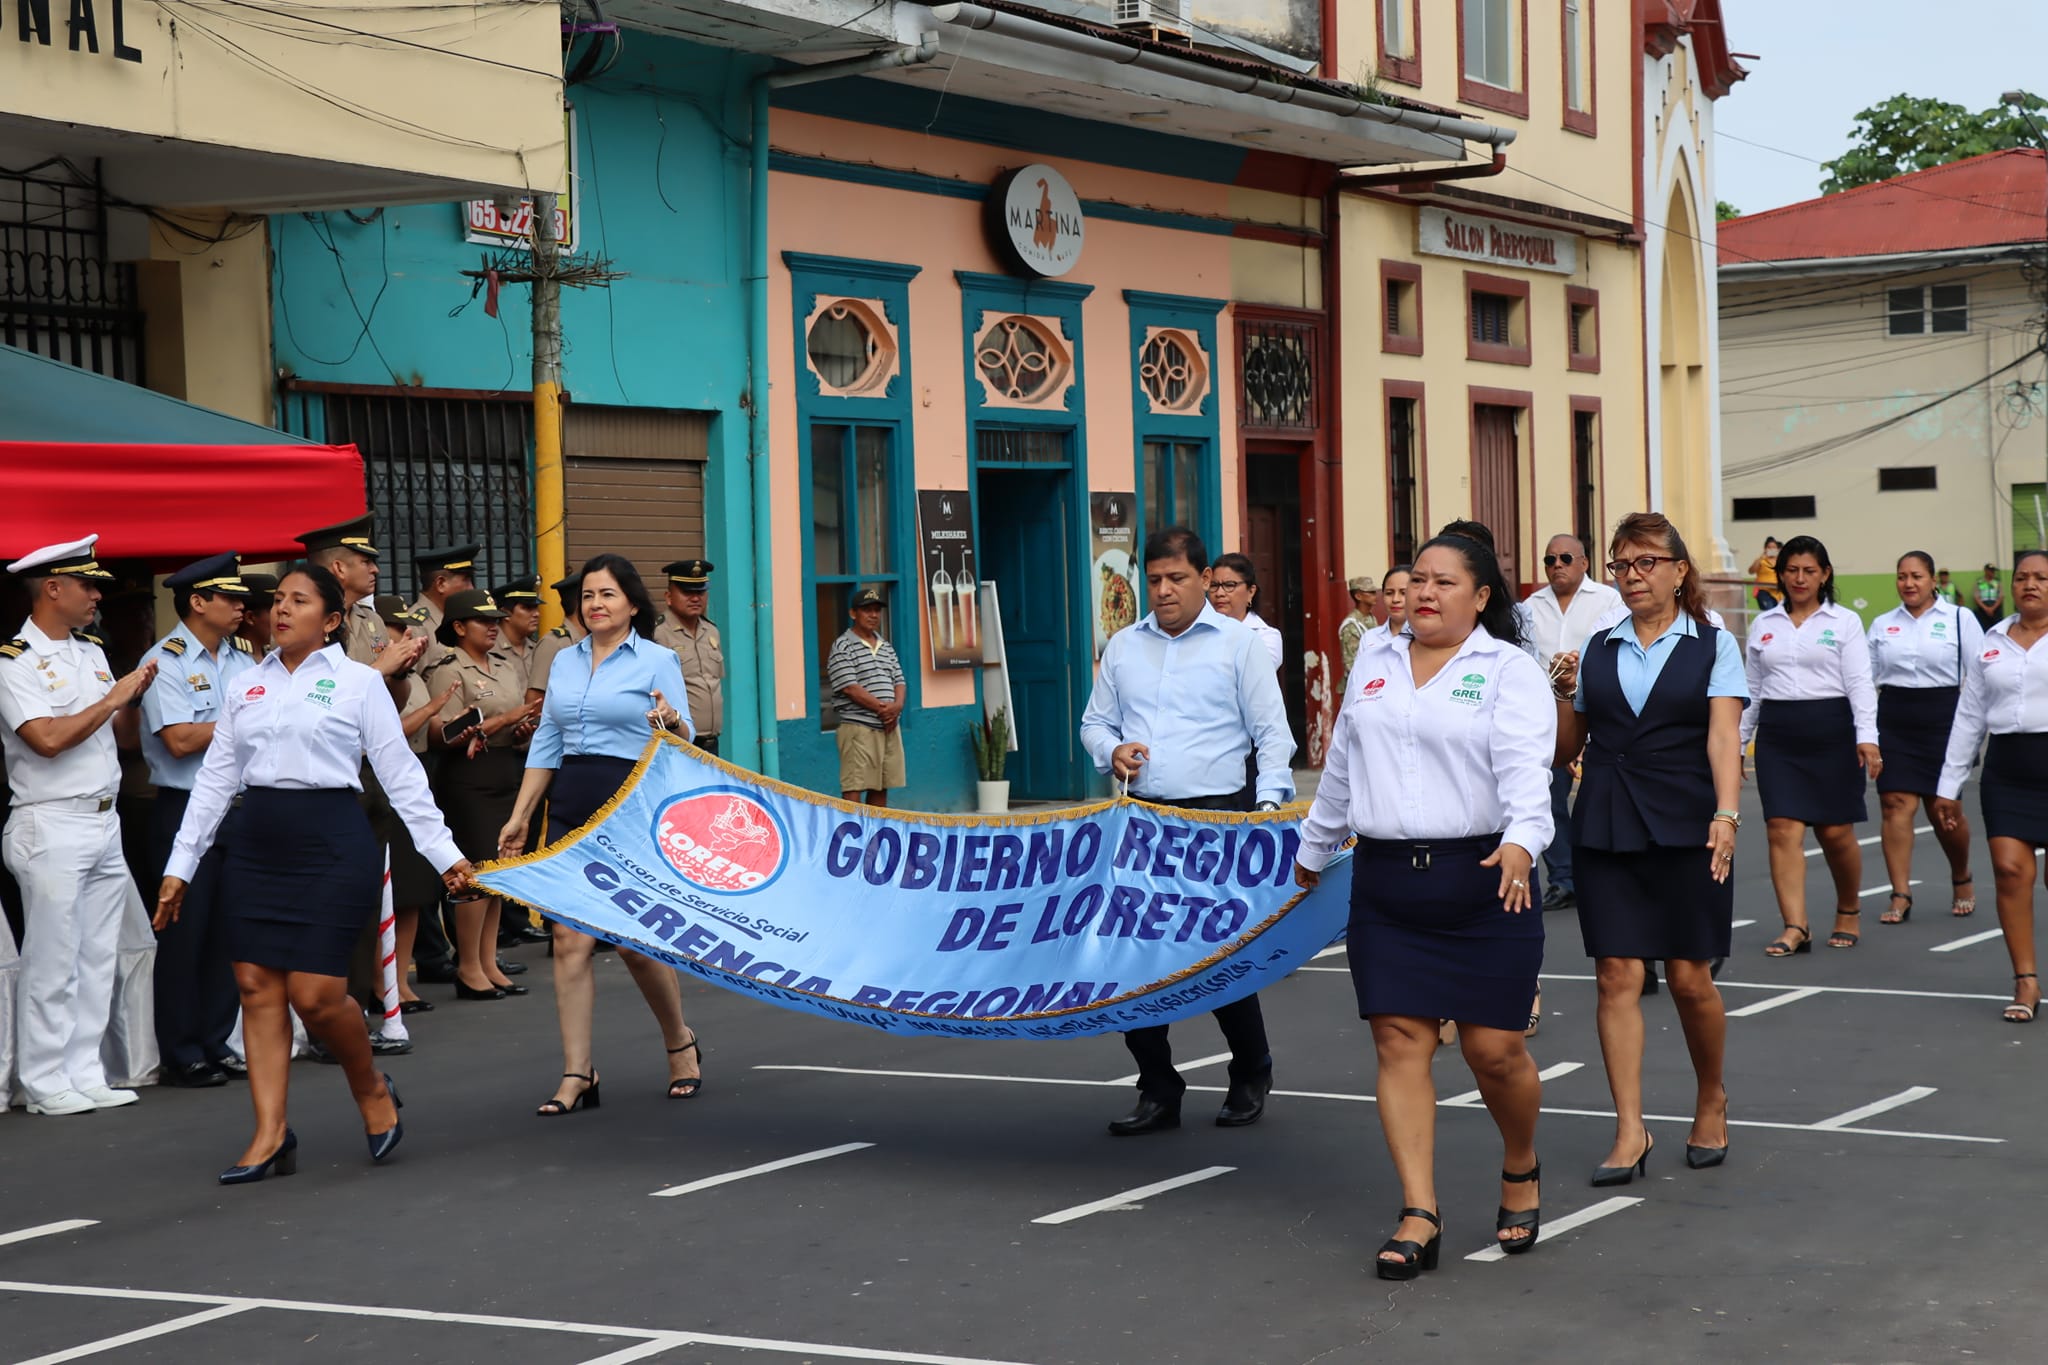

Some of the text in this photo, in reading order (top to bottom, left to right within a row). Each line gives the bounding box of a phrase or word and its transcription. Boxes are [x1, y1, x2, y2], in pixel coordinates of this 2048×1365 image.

[0, 0, 142, 64] NAL
[1010, 207, 1080, 237] MARTINA
[1452, 689, 1483, 701] GREL
[659, 820, 767, 887] LORETO
[826, 820, 1102, 893] GOBIERNO
[582, 861, 833, 995] GERENCIA
[658, 881, 682, 897] de
[682, 893, 751, 924] Servicio
[750, 918, 810, 943] Social
[936, 885, 1249, 952] DE LORETO
